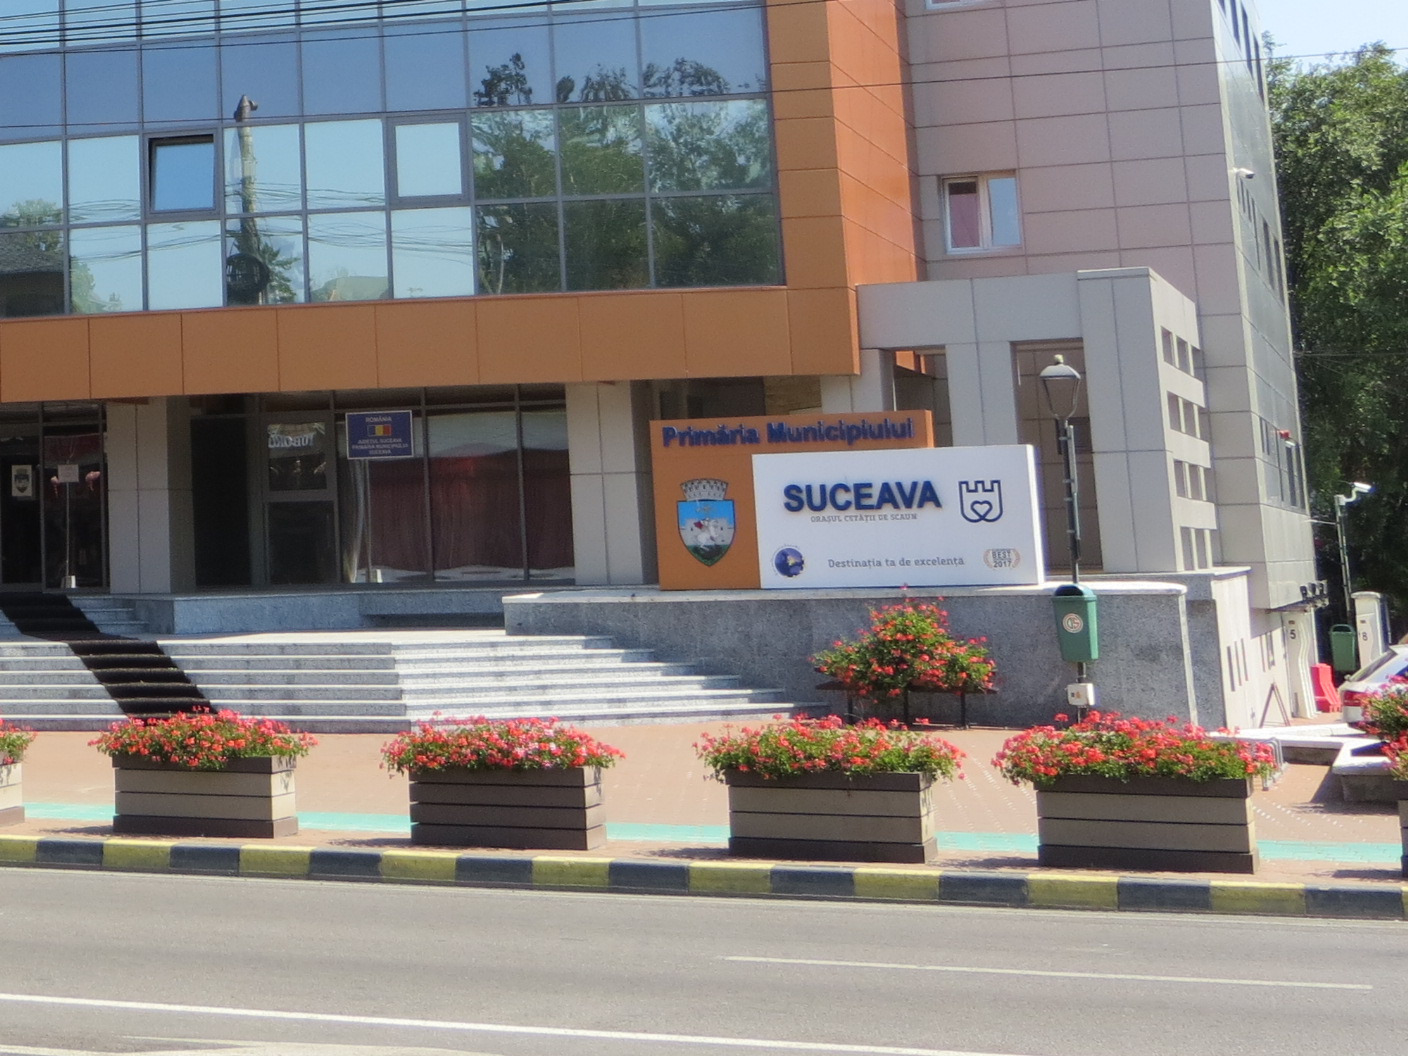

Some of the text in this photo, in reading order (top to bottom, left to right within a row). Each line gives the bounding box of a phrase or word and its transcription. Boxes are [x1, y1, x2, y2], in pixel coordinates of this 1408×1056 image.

[662, 418, 914, 447] Primăria Municipiului
[783, 480, 942, 513] SUCEAVA
[891, 513, 918, 521] SCAUN
[992, 551, 1011, 559] BEST
[885, 558, 896, 567] ta
[898, 557, 912, 567] de
[993, 560, 1012, 568] 2017
